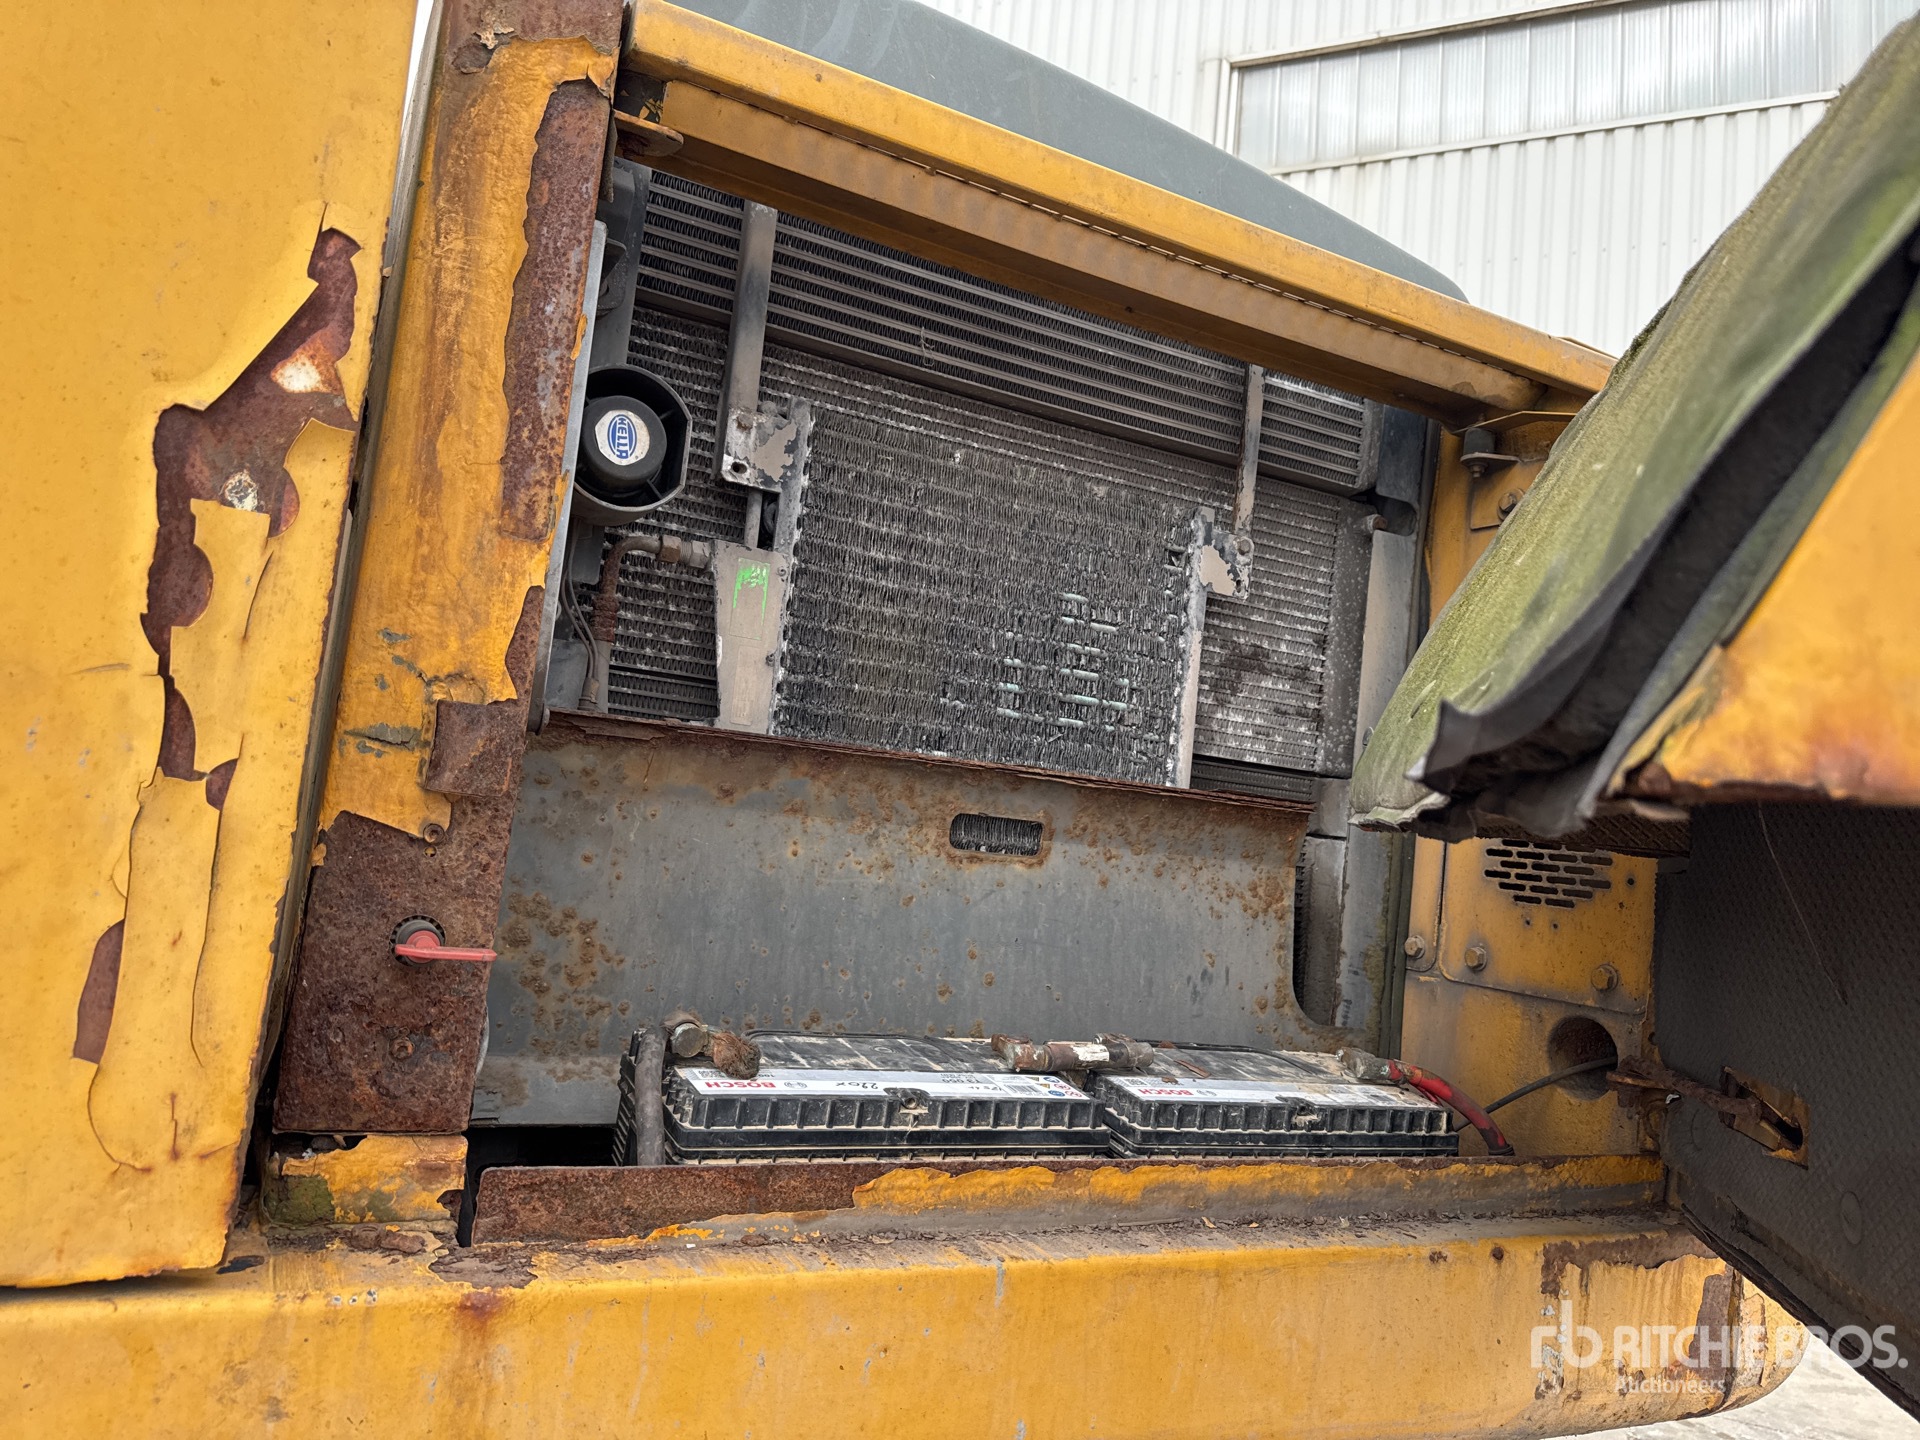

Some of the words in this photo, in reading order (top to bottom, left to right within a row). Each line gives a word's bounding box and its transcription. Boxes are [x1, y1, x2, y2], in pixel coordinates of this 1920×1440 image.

[616, 418, 628, 458] HELLA
[704, 1081, 777, 1089] BOSCH
[1138, 1088, 1194, 1096] BOSCH
